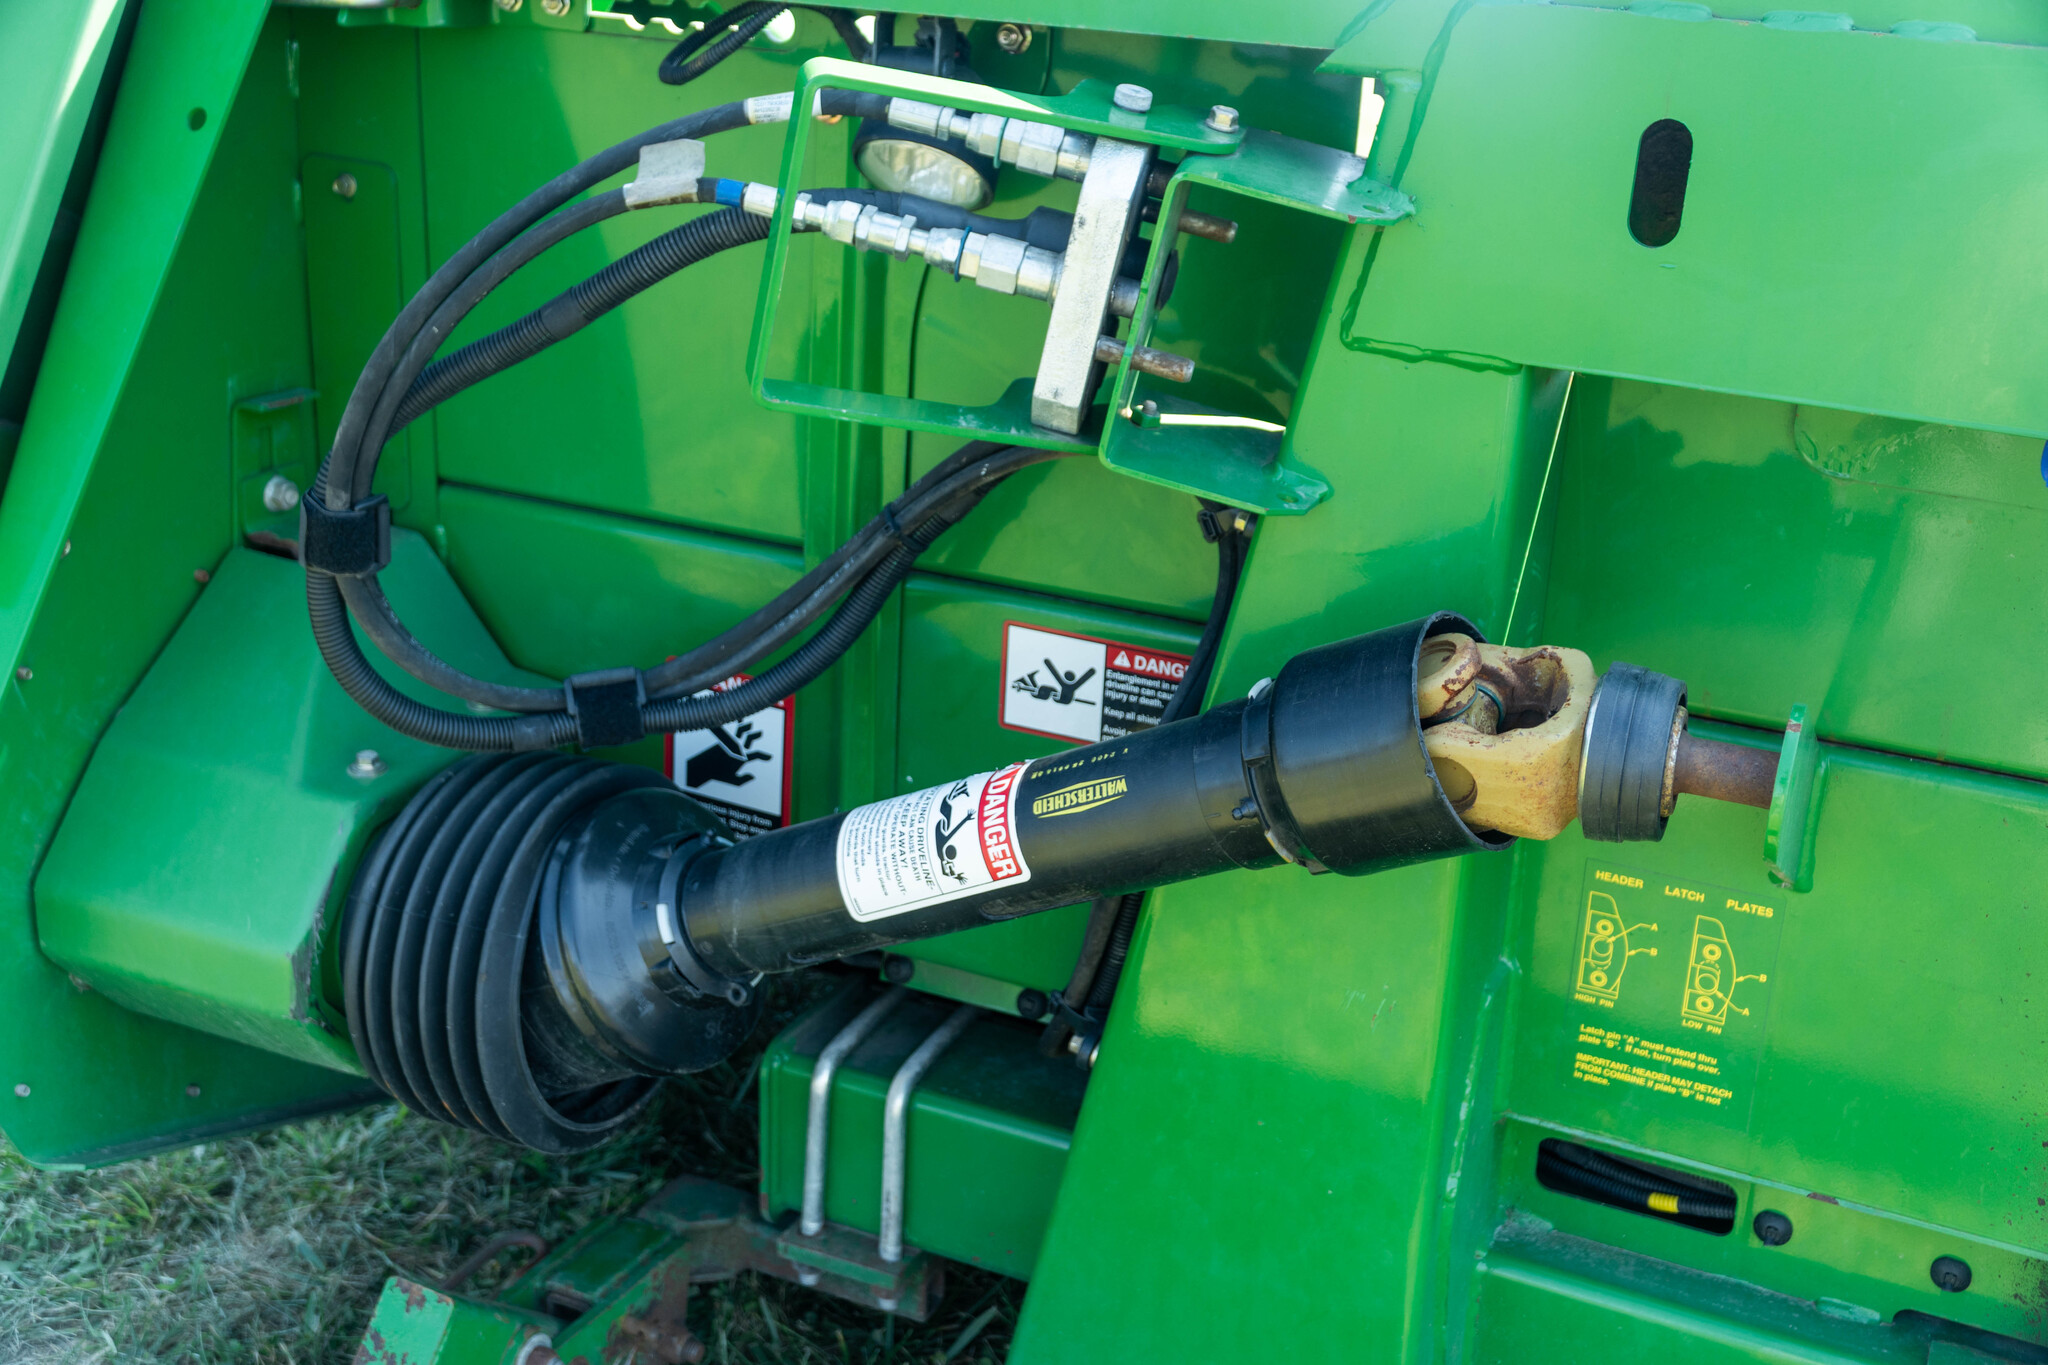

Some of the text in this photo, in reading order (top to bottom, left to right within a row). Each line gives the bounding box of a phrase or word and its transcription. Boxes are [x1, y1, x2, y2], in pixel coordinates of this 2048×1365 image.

[1134, 654, 1189, 679] DANG
[1105, 668, 1161, 689] Entanglement
[1161, 681, 1170, 690] in
[1105, 679, 1140, 694] driveline
[1140, 687, 1156, 697] can
[1156, 690, 1174, 701] cau
[1104, 688, 1164, 709] injury or death.
[1103, 705, 1125, 719] Keep
[1125, 711, 1136, 721] all
[1102, 723, 1126, 736] Avoid
[1033, 777, 1128, 815] WALTERSCHEID
[728, 807, 752, 823] injury
[752, 814, 773, 828] from
[901, 802, 912, 827] KEEP
[983, 777, 1018, 879] DANGER
[899, 830, 909, 868] AWAY!
[910, 856, 921, 881] DEATH
[1595, 869, 1774, 918] HEADER LATCH PLATES
[1650, 923, 1658, 932] A
[1650, 947, 1658, 956] B
[1759, 973, 1767, 983] B
[1574, 992, 1615, 1008] HIGH PIN
[1742, 1007, 1750, 1016] A
[1681, 1018, 1723, 1035] LOW PIN
[1578, 1033, 1601, 1045] plate
[1624, 1044, 1633, 1053] If
[1633, 1047, 1651, 1059] not,
[1652, 1051, 1672, 1063] turn
[1672, 1057, 1696, 1069] plate
[1580, 1023, 1605, 1037] Latch
[1606, 1031, 1621, 1041] pin
[1640, 1040, 1664, 1052] must
[1664, 1046, 1697, 1060] extend
[1697, 1053, 1718, 1065] thru
[1573, 1069, 1610, 1087] in place.
[1574, 1060, 1602, 1074] FROM
[1602, 1068, 1646, 1086] COMBINE
[1646, 1079, 1655, 1089] if
[1654, 1082, 1677, 1094] plate
[1695, 1091, 1704, 1102] is
[1705, 1095, 1722, 1106] not
[1575, 1052, 1733, 1099] IMPORTANT: HEADER MAY DETACH
